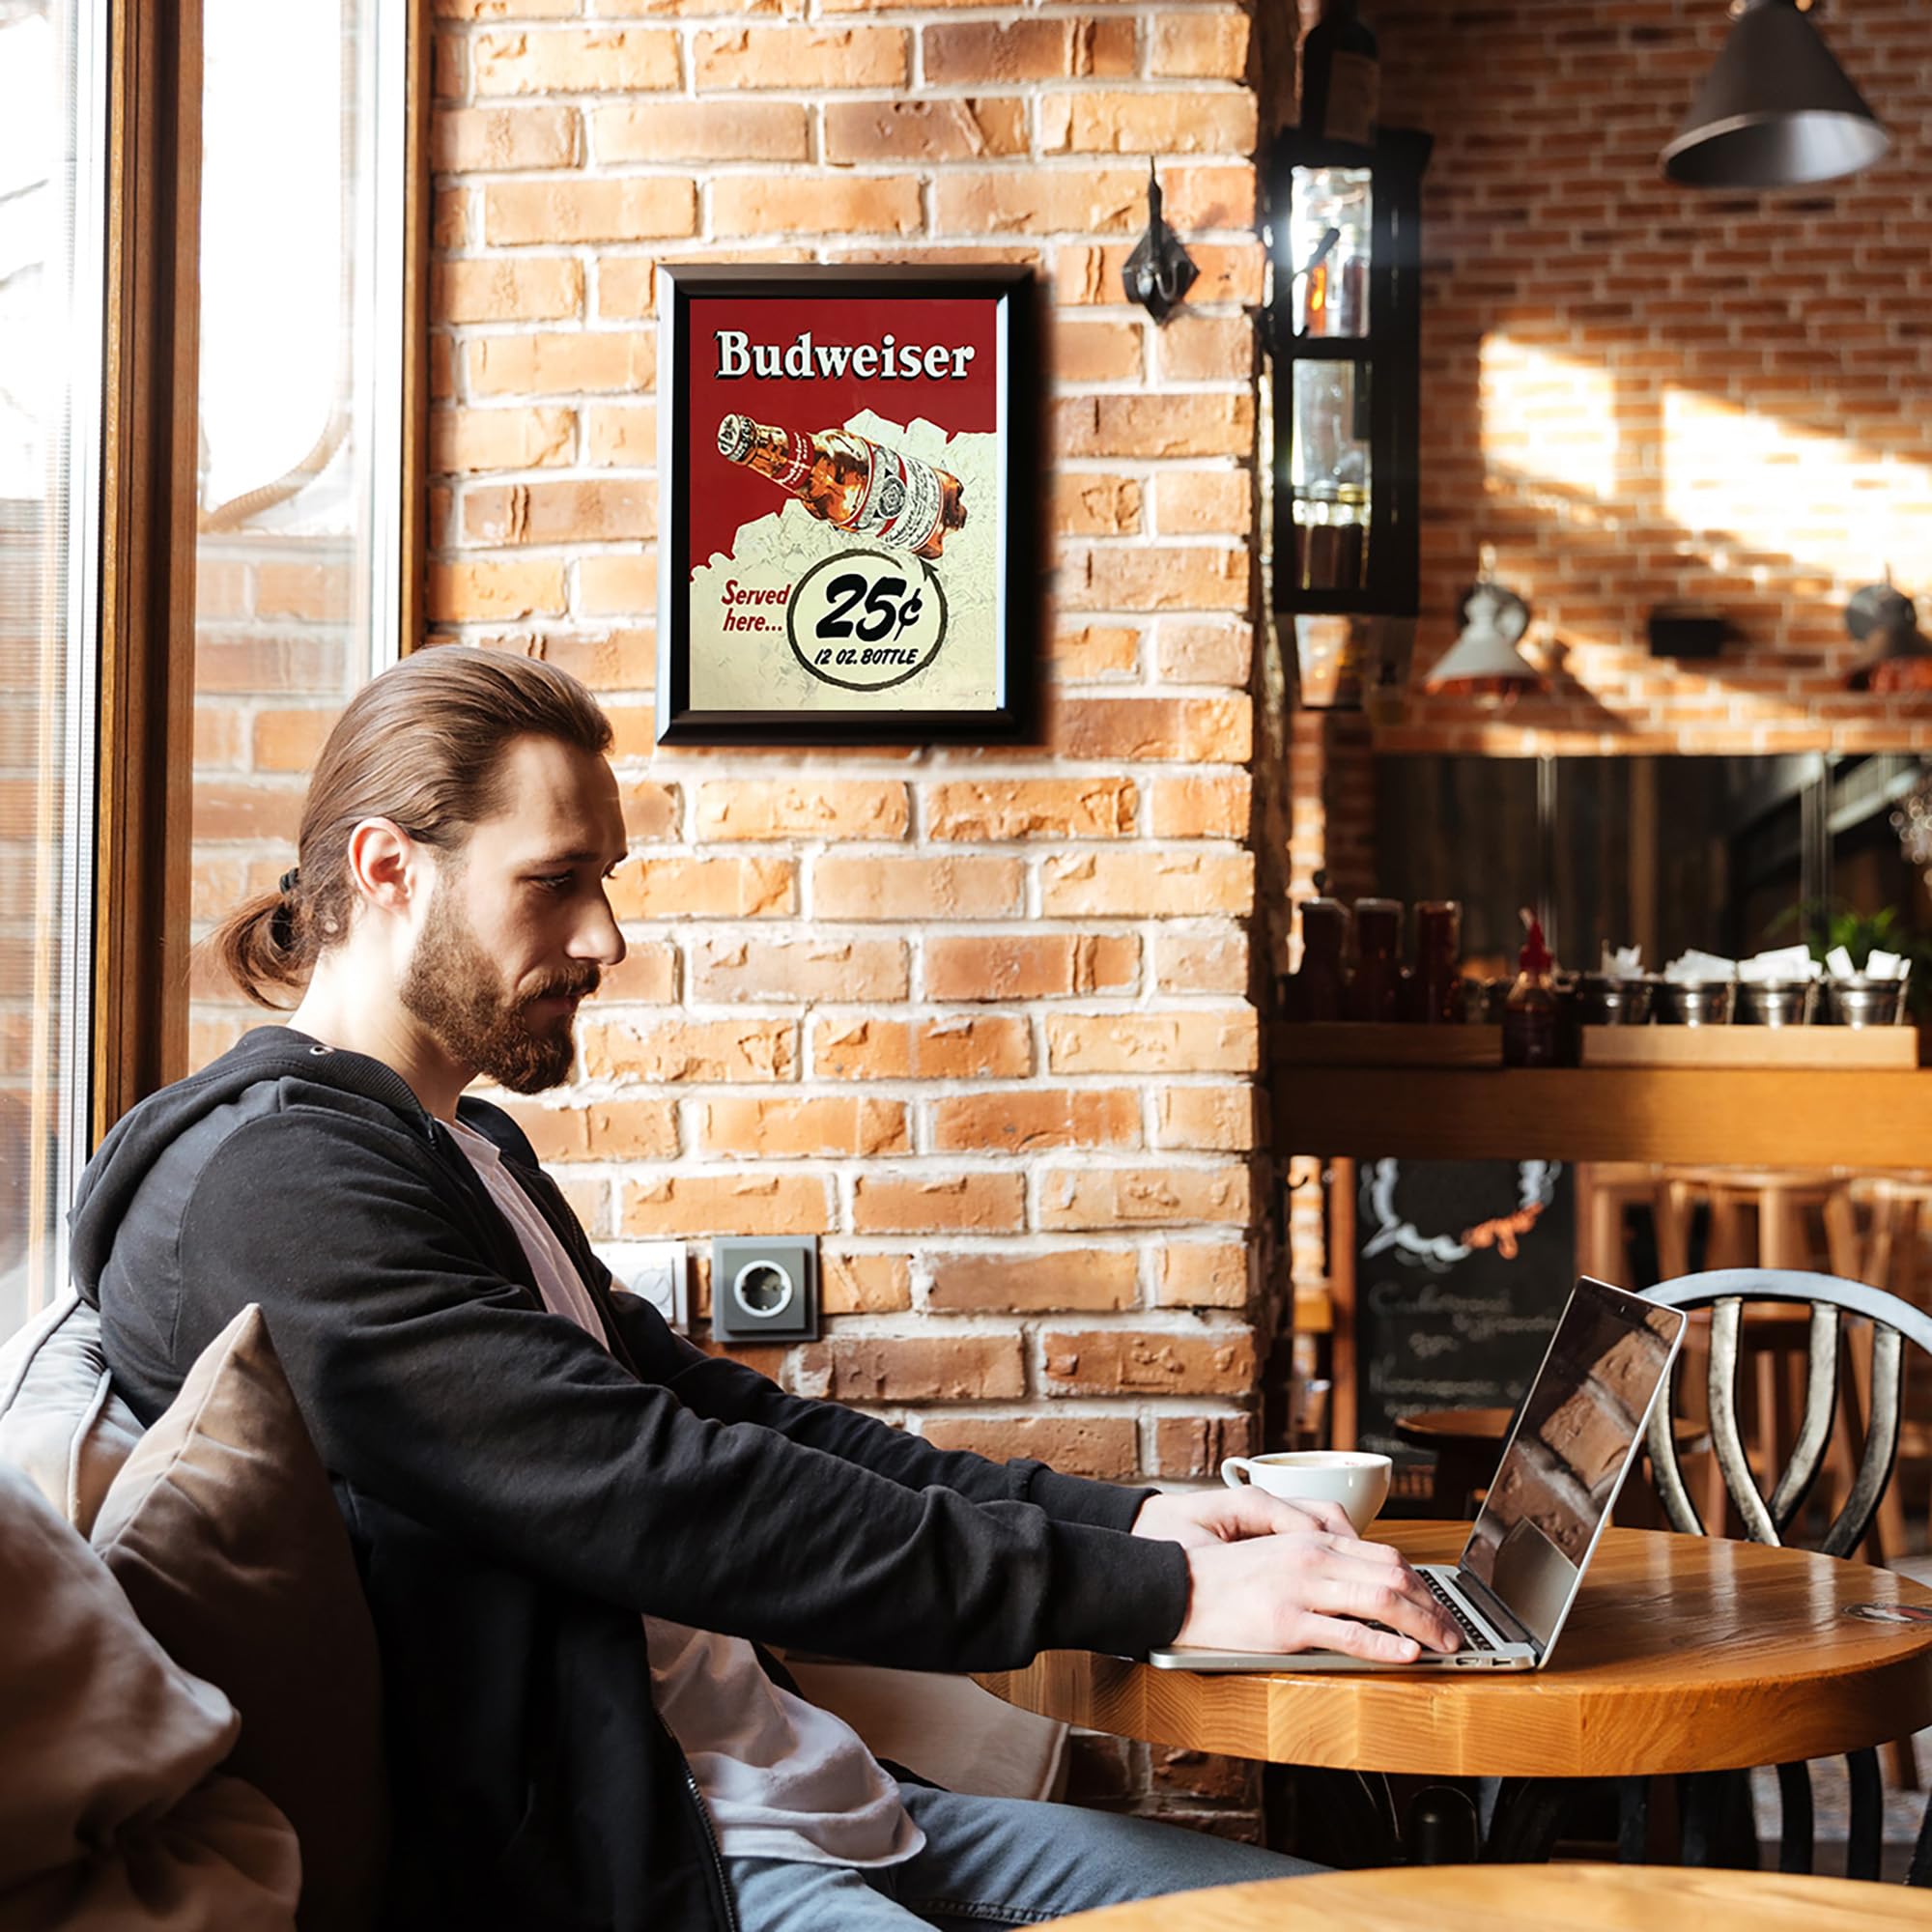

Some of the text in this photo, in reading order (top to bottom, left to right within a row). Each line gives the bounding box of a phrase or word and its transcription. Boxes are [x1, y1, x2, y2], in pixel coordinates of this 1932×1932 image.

[715, 330, 975, 379] Budweiser
[721, 579, 791, 605] Served
[723, 607, 782, 631] here...
[815, 573, 923, 642] 25¢
[814, 647, 919, 665] 12 OZ. BOTTLE
